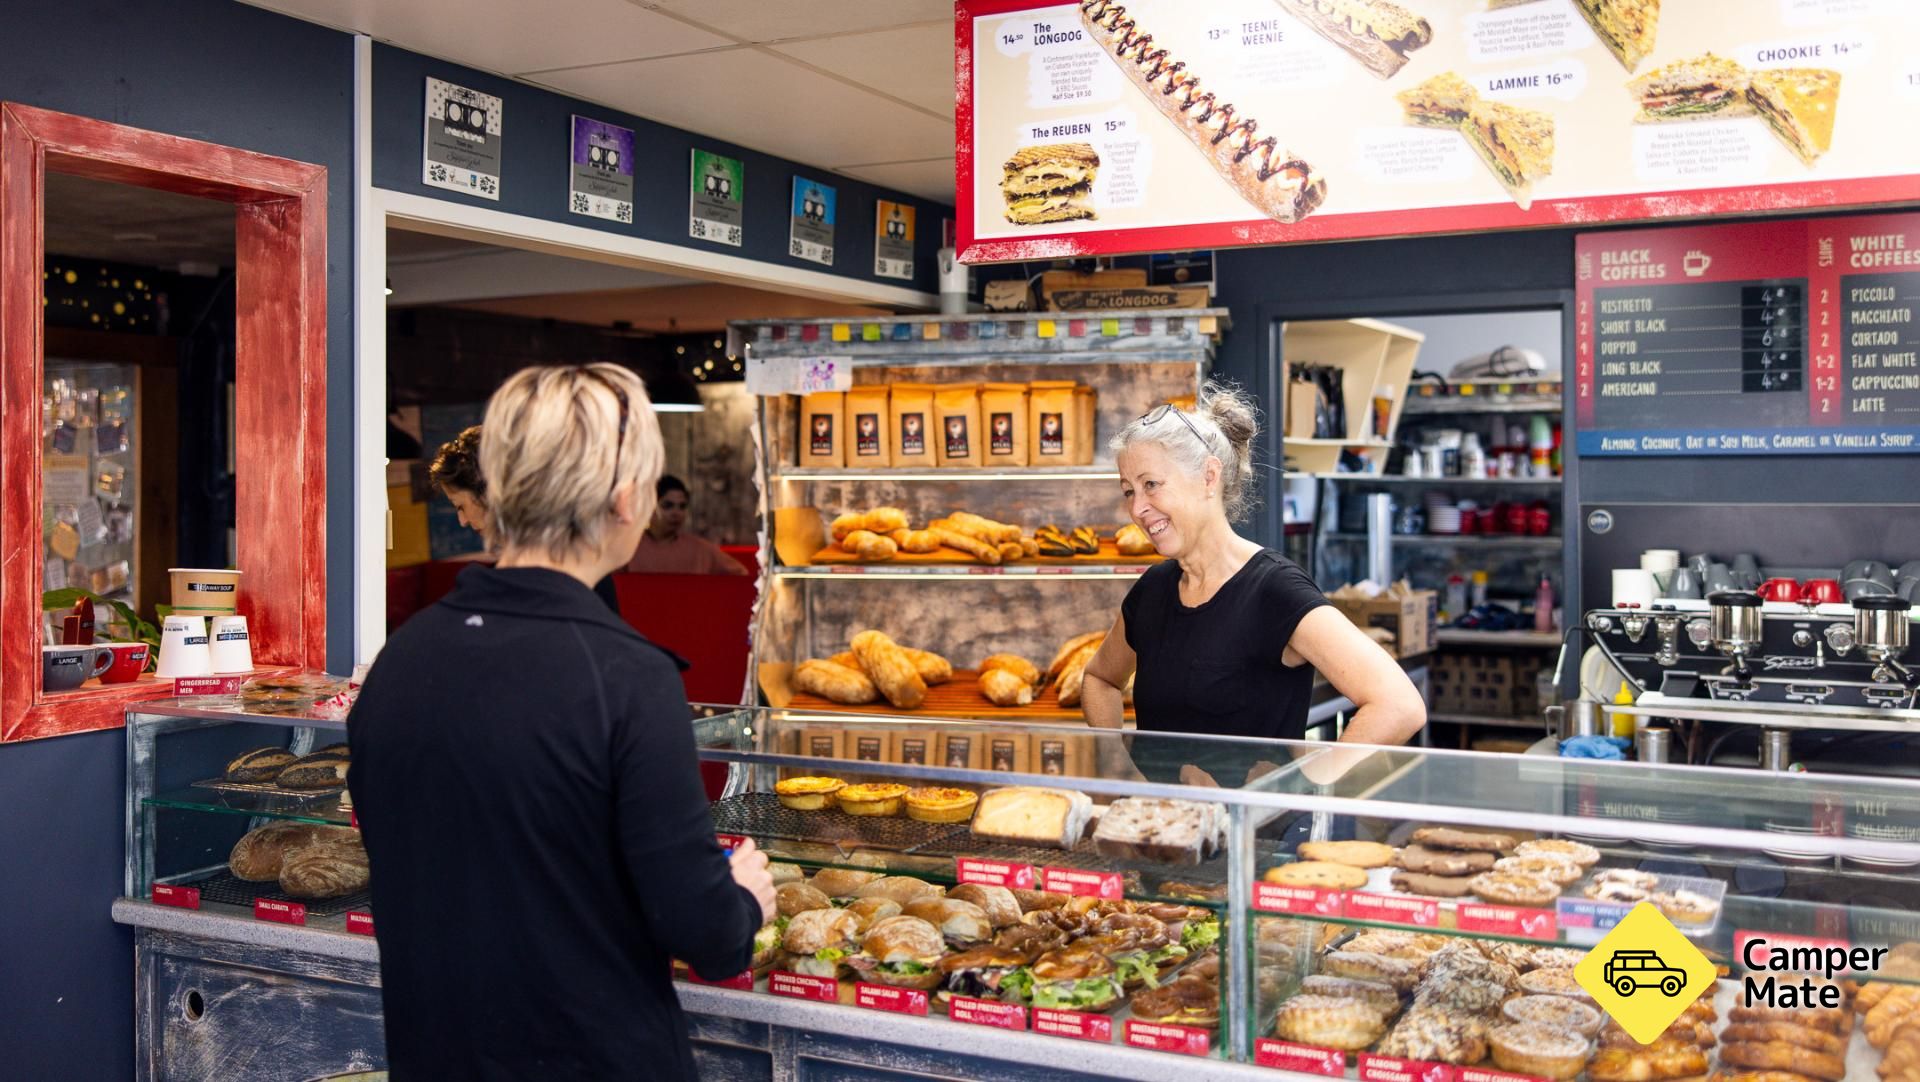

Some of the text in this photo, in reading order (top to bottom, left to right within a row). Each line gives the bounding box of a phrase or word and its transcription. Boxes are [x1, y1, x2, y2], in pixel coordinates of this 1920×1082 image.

[1033, 22, 1051, 34] The
[1241, 19, 1279, 33] TEENIE
[1034, 30, 1082, 46] LONGDOG
[1241, 31, 1284, 46] WEENIE
[1757, 44, 1822, 62] CHOOKIE
[1489, 75, 1540, 91] LAMMIE
[1064, 91, 1075, 99] Size
[1032, 127, 1050, 139] The
[1052, 123, 1091, 137] REUBEN
[1849, 234, 1905, 251] WHITE
[1601, 248, 1651, 266] BLACK
[1849, 249, 1920, 268] COFFEES
[1600, 263, 1666, 281] COFFEES
[1109, 294, 1169, 308] LONGDOG
[1820, 286, 1896, 304] 2 PICCOLO
[1580, 298, 1653, 314] 2 RISTRETTO
[1820, 308, 1912, 325] 2 MACCHIATO
[1580, 318, 1666, 335] 2 SHORT BLACK
[1821, 331, 1898, 348] 2 CORTADO
[1601, 340, 1637, 355] DOPPIO
[1815, 351, 1917, 369] 1-2 FLAT WHITE
[1580, 360, 1662, 376] 2 LONG BLACK
[1580, 381, 1657, 397] 2 AMERICANO
[1815, 374, 1920, 391] 1-2 CAPPUCCINO
[1821, 397, 1886, 413] 2 LATTE
[1686, 435, 1705, 449] OAT
[1772, 433, 1816, 449] CARAMEL
[1833, 433, 1876, 448] VANILLA
[1880, 432, 1914, 448] SYRUP
[58, 657, 78, 665] LARGE
[180, 679, 221, 687] GINGERBREAD
[1047, 870, 1066, 881] APPLE
[1259, 885, 1293, 898] SULTANA
[1259, 896, 1290, 908] COOKIE
[1352, 894, 1383, 908] PEANUT
[1495, 910, 1517, 921] TART
[774, 974, 819, 987] SMOKED CHICKEN
[774, 983, 806, 994] & BRIE ROLL
[860, 985, 900, 999] SALAMI SALAD
[860, 995, 875, 1005] ROLL
[954, 999, 1003, 1014] FILLED PRETZEL
[954, 1009, 972, 1019] ROLL
[1037, 1010, 1082, 1025] HAM & CHEESE
[1037, 1020, 1083, 1035] FILLED PRETZEL
[1130, 1023, 1185, 1039] MUSTARD BUTTER
[1130, 1033, 1157, 1045] PRETZEL
[1261, 1042, 1329, 1061] APPLE TURNOVER
[1365, 1057, 1402, 1072] ALMOND
[1366, 1068, 1412, 1082] CROISSANT
[1463, 1071, 1491, 1082] BERRY
